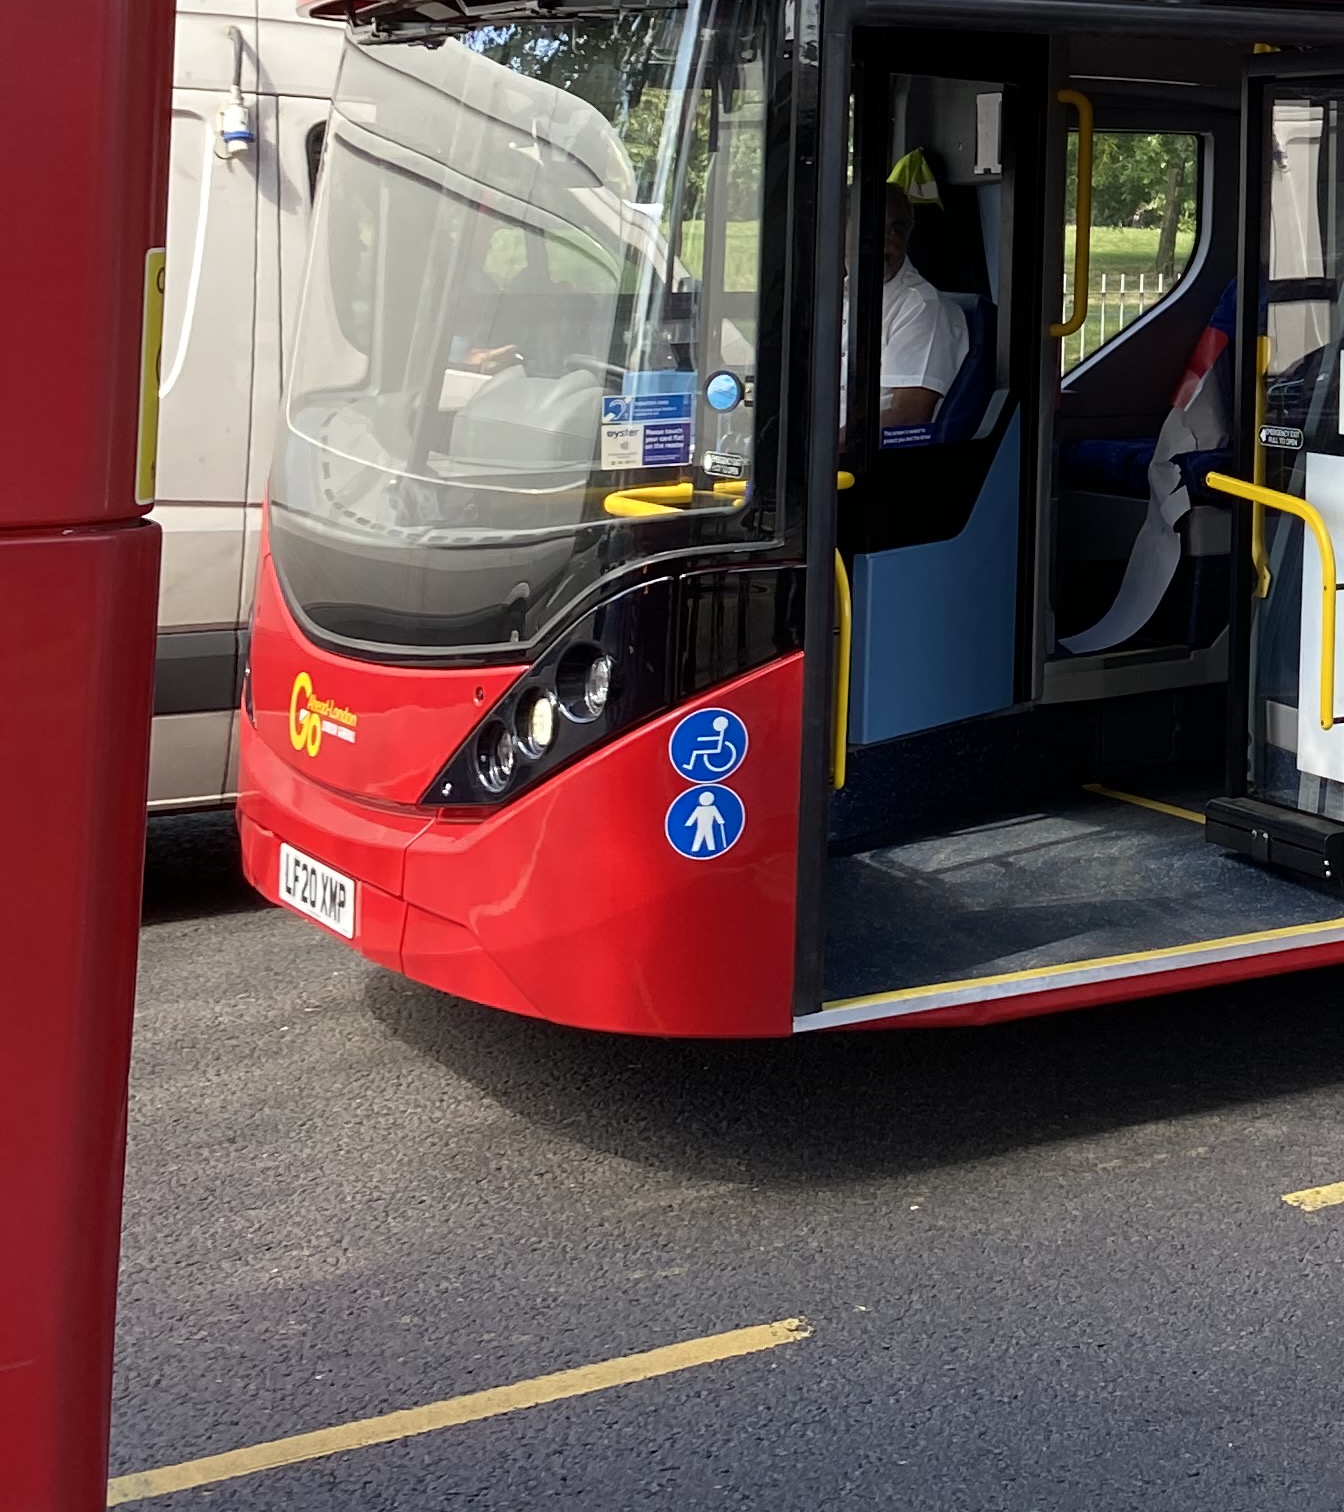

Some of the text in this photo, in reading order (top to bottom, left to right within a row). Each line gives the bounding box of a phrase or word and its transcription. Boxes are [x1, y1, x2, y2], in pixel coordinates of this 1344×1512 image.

[289, 671, 321, 758] Go
[286, 852, 346, 923] LF20 XMP
